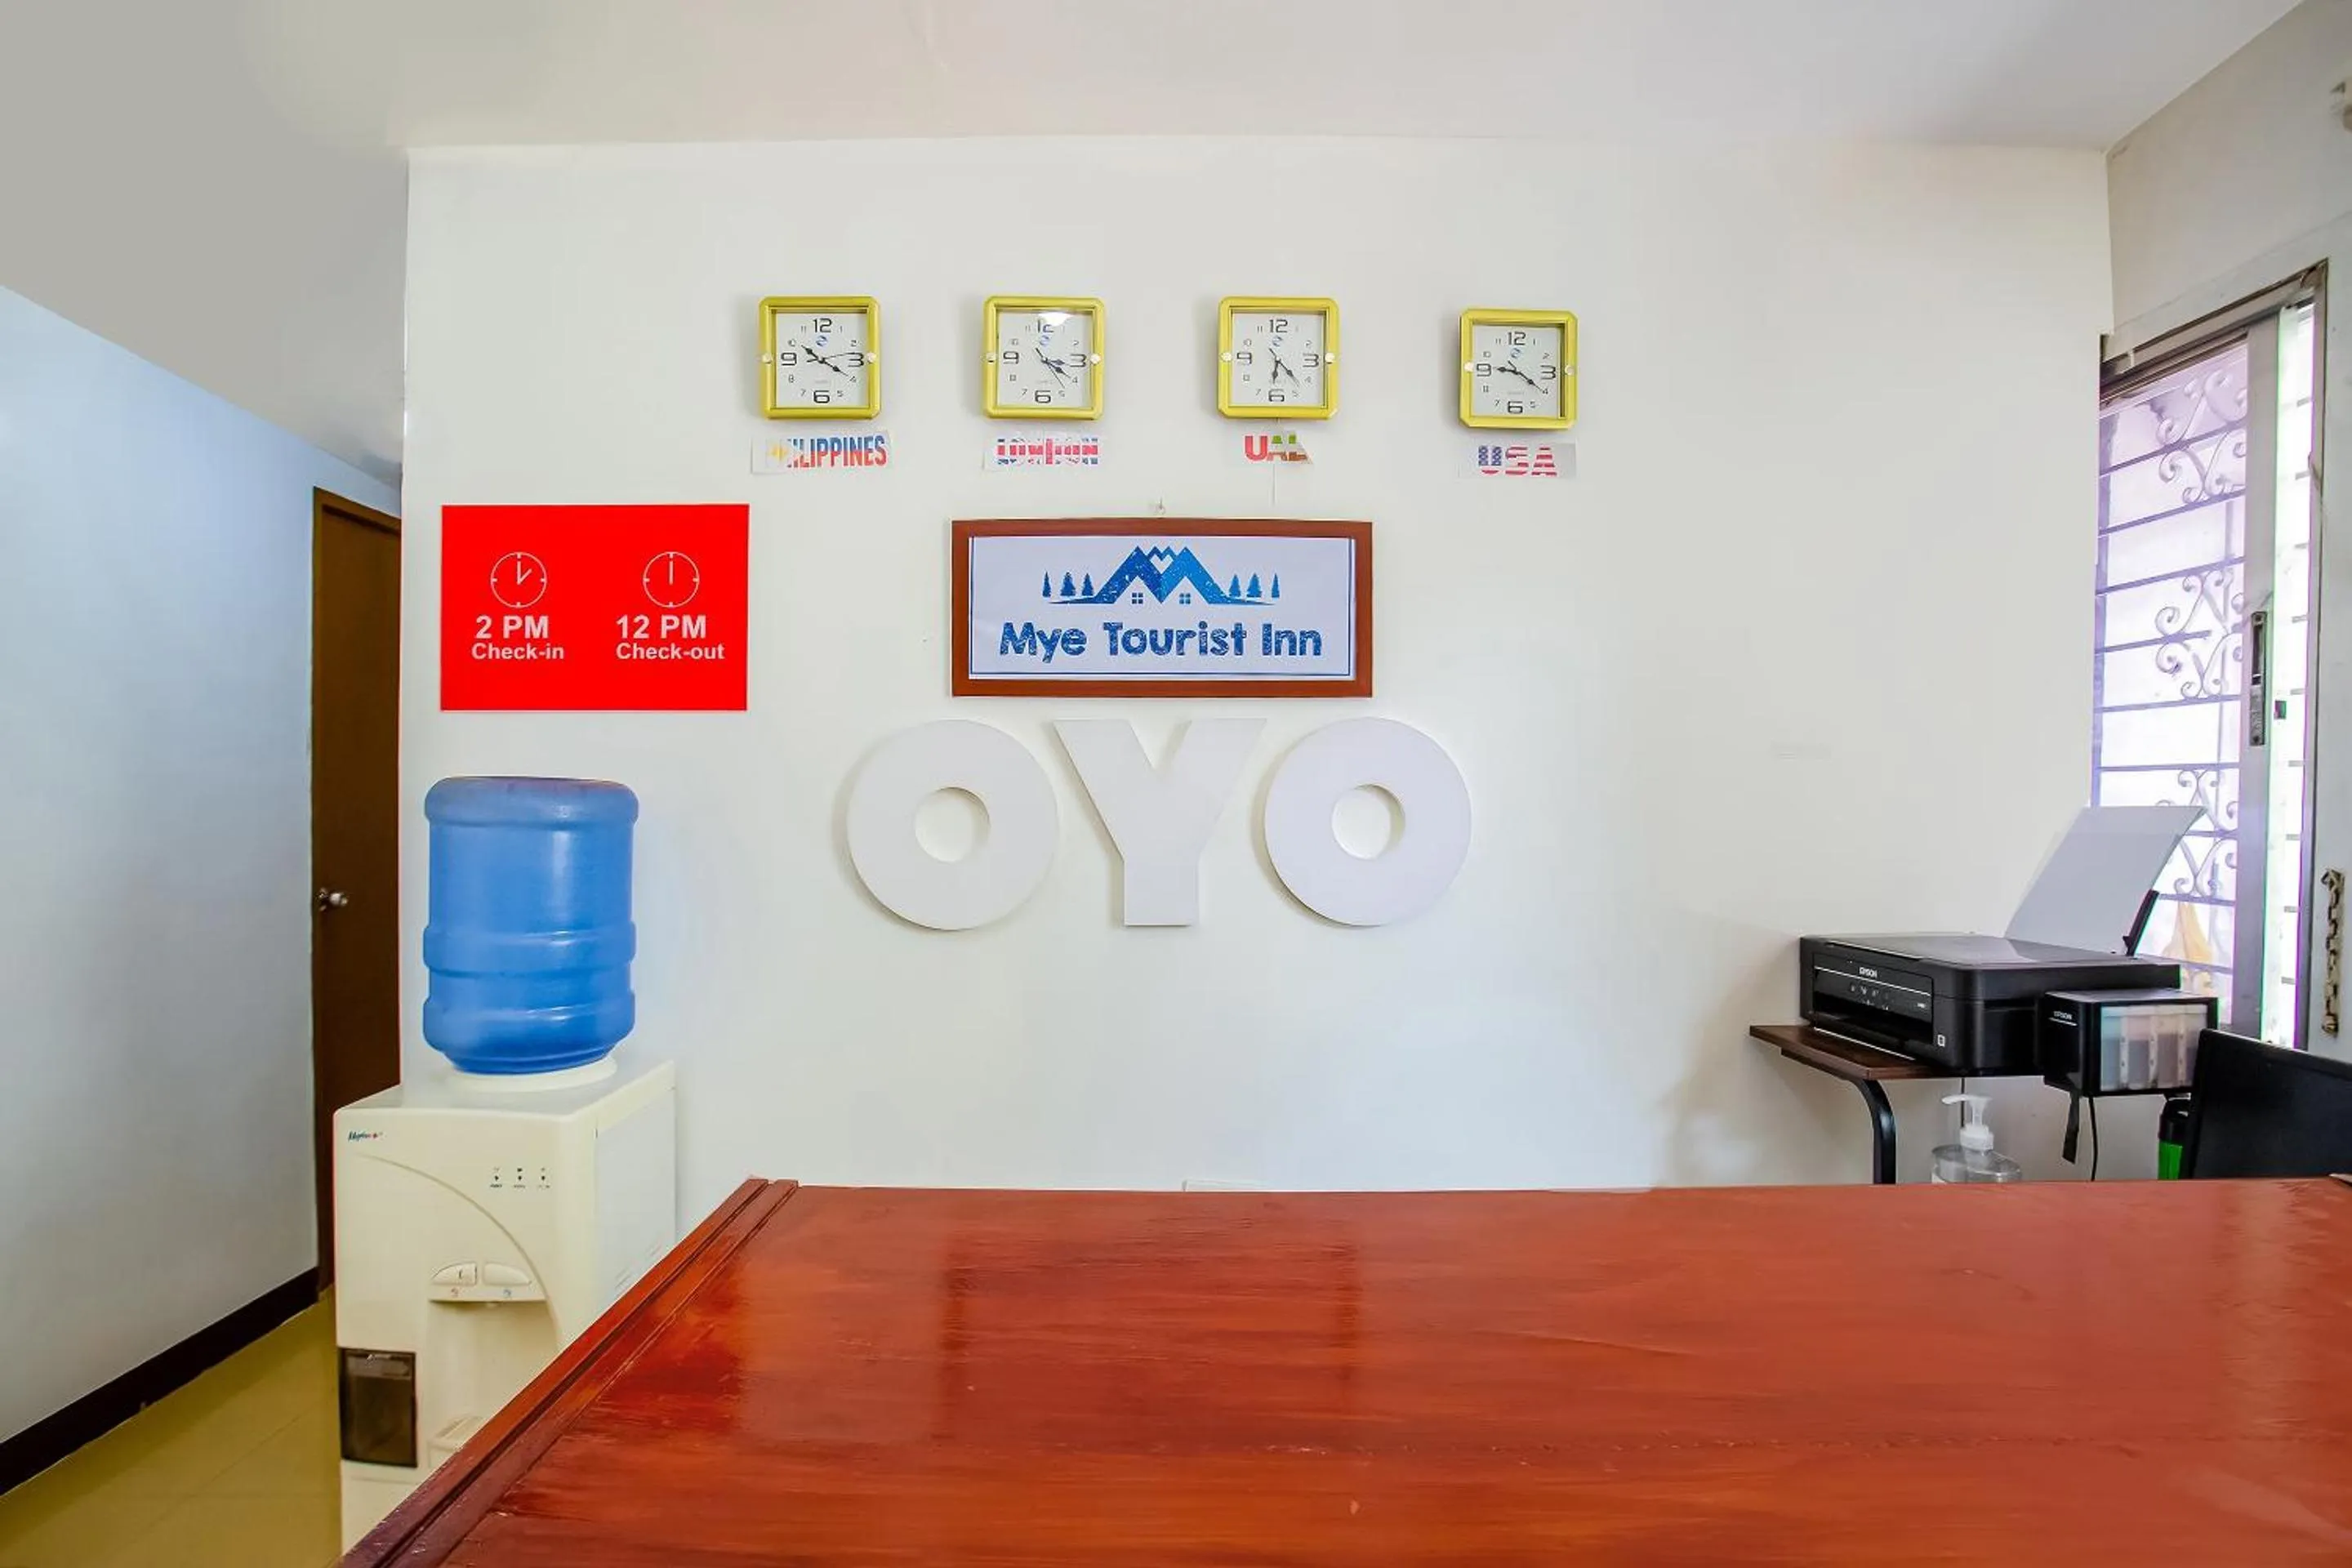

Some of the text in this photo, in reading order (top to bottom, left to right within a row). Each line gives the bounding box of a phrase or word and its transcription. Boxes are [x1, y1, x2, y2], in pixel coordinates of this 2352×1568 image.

[813, 318, 832, 333] 12
[1269, 318, 1288, 333] 12
[1508, 332, 1526, 345] 12
[781, 352, 797, 366] 9
[848, 352, 864, 368] 3
[1003, 350, 1019, 364] 9
[1070, 354, 1087, 368] 3
[1303, 353, 1319, 368] 3
[1477, 363, 1491, 377] 9
[1540, 364, 1557, 380] 3
[813, 390, 831, 403] 6
[1035, 390, 1052, 403] 6
[1268, 389, 1285, 402] 6
[1508, 401, 1523, 414] 6
[767, 435, 887, 469] ILIPPINES
[1478, 445, 1557, 476] USA
[475, 614, 550, 639] 2 PM
[616, 614, 706, 639] 12 PM
[1000, 620, 1322, 664] Mye Tourist Inn
[471, 642, 564, 660] Check-in
[616, 642, 725, 660] Check-out
[847, 716, 1472, 930] OYO
